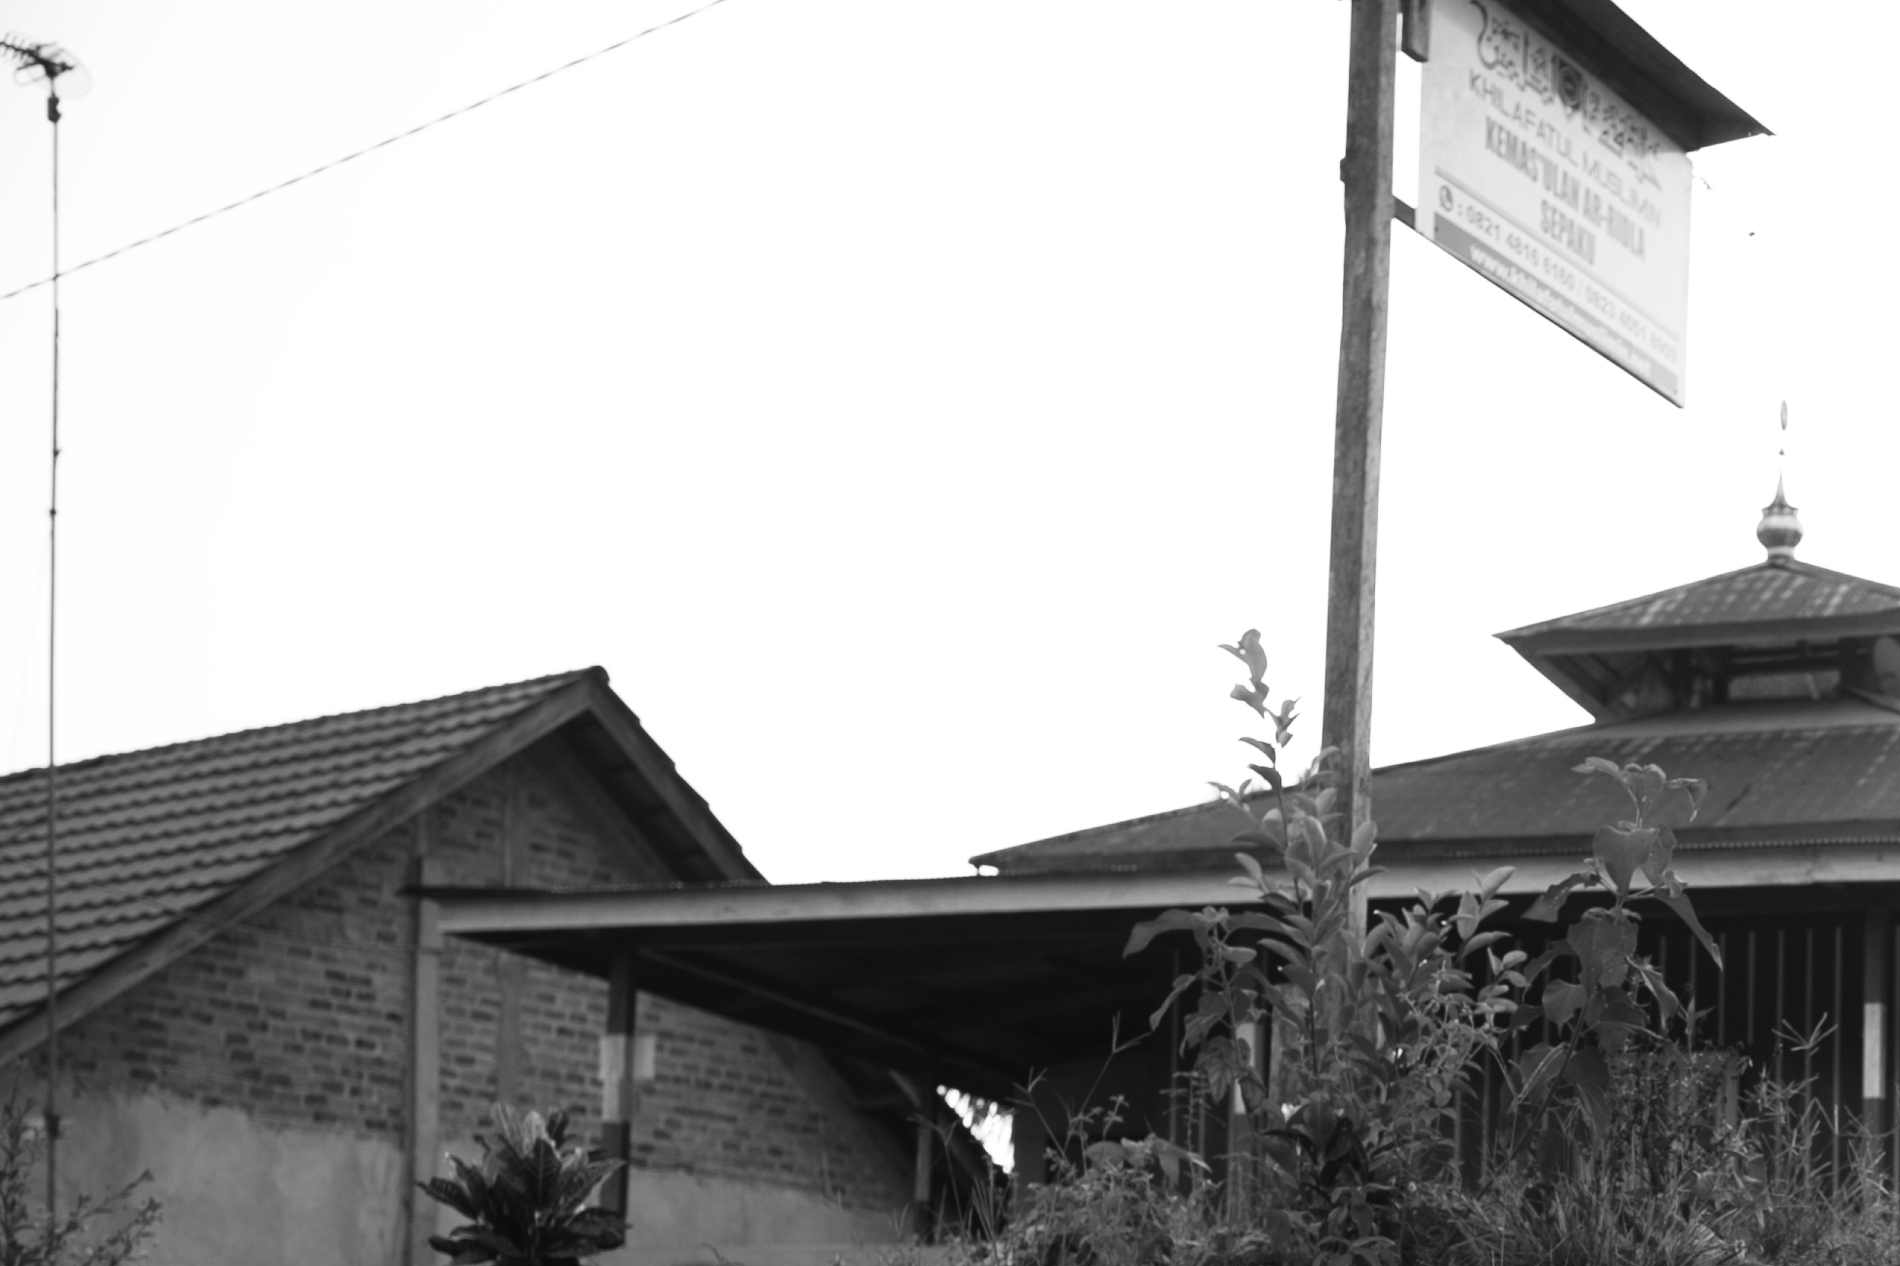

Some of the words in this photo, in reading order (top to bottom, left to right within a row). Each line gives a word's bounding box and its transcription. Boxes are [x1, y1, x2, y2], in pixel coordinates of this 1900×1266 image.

[1468, 67, 1579, 169] KHILAFATUL
[1581, 148, 1661, 230] MUSLIMIN
[1466, 203, 1500, 242] 0821
[1540, 197, 1595, 266] SEPAKU
